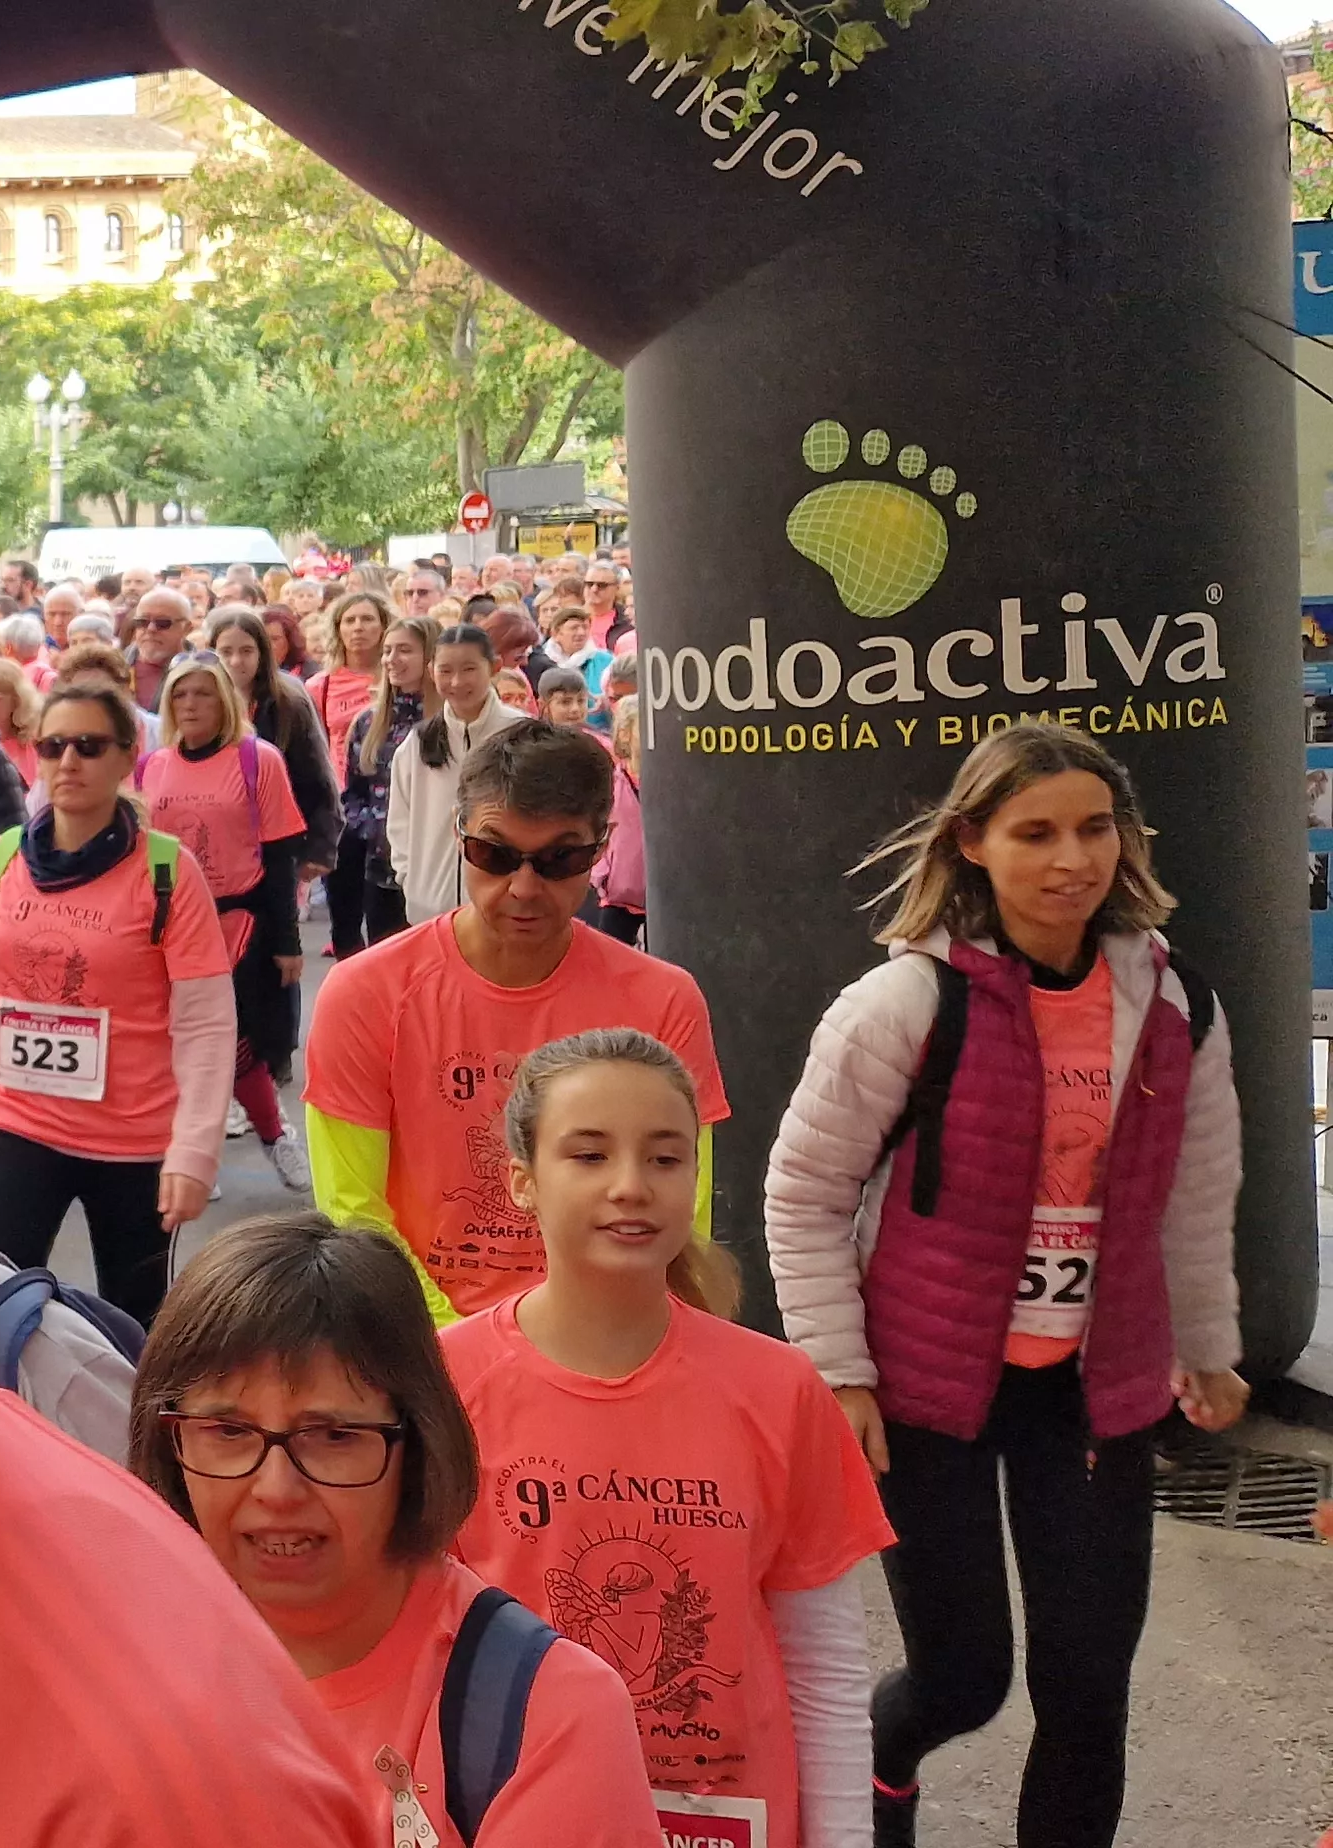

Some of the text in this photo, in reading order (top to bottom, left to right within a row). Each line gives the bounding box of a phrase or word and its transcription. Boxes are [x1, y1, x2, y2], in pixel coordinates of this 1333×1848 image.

[517, 0, 620, 56] ve
[685, 714, 879, 753] PODOLOGÍA
[894, 718, 919, 747] Y
[12, 1034, 80, 1074] 523
[452, 1065, 486, 1101] 9ª
[1017, 1254, 1094, 1304] 52
[515, 1468, 722, 1530] 9ª CÁNCER
[652, 1505, 748, 1531] HUESCA
[650, 1722, 721, 1742] MUCHO
